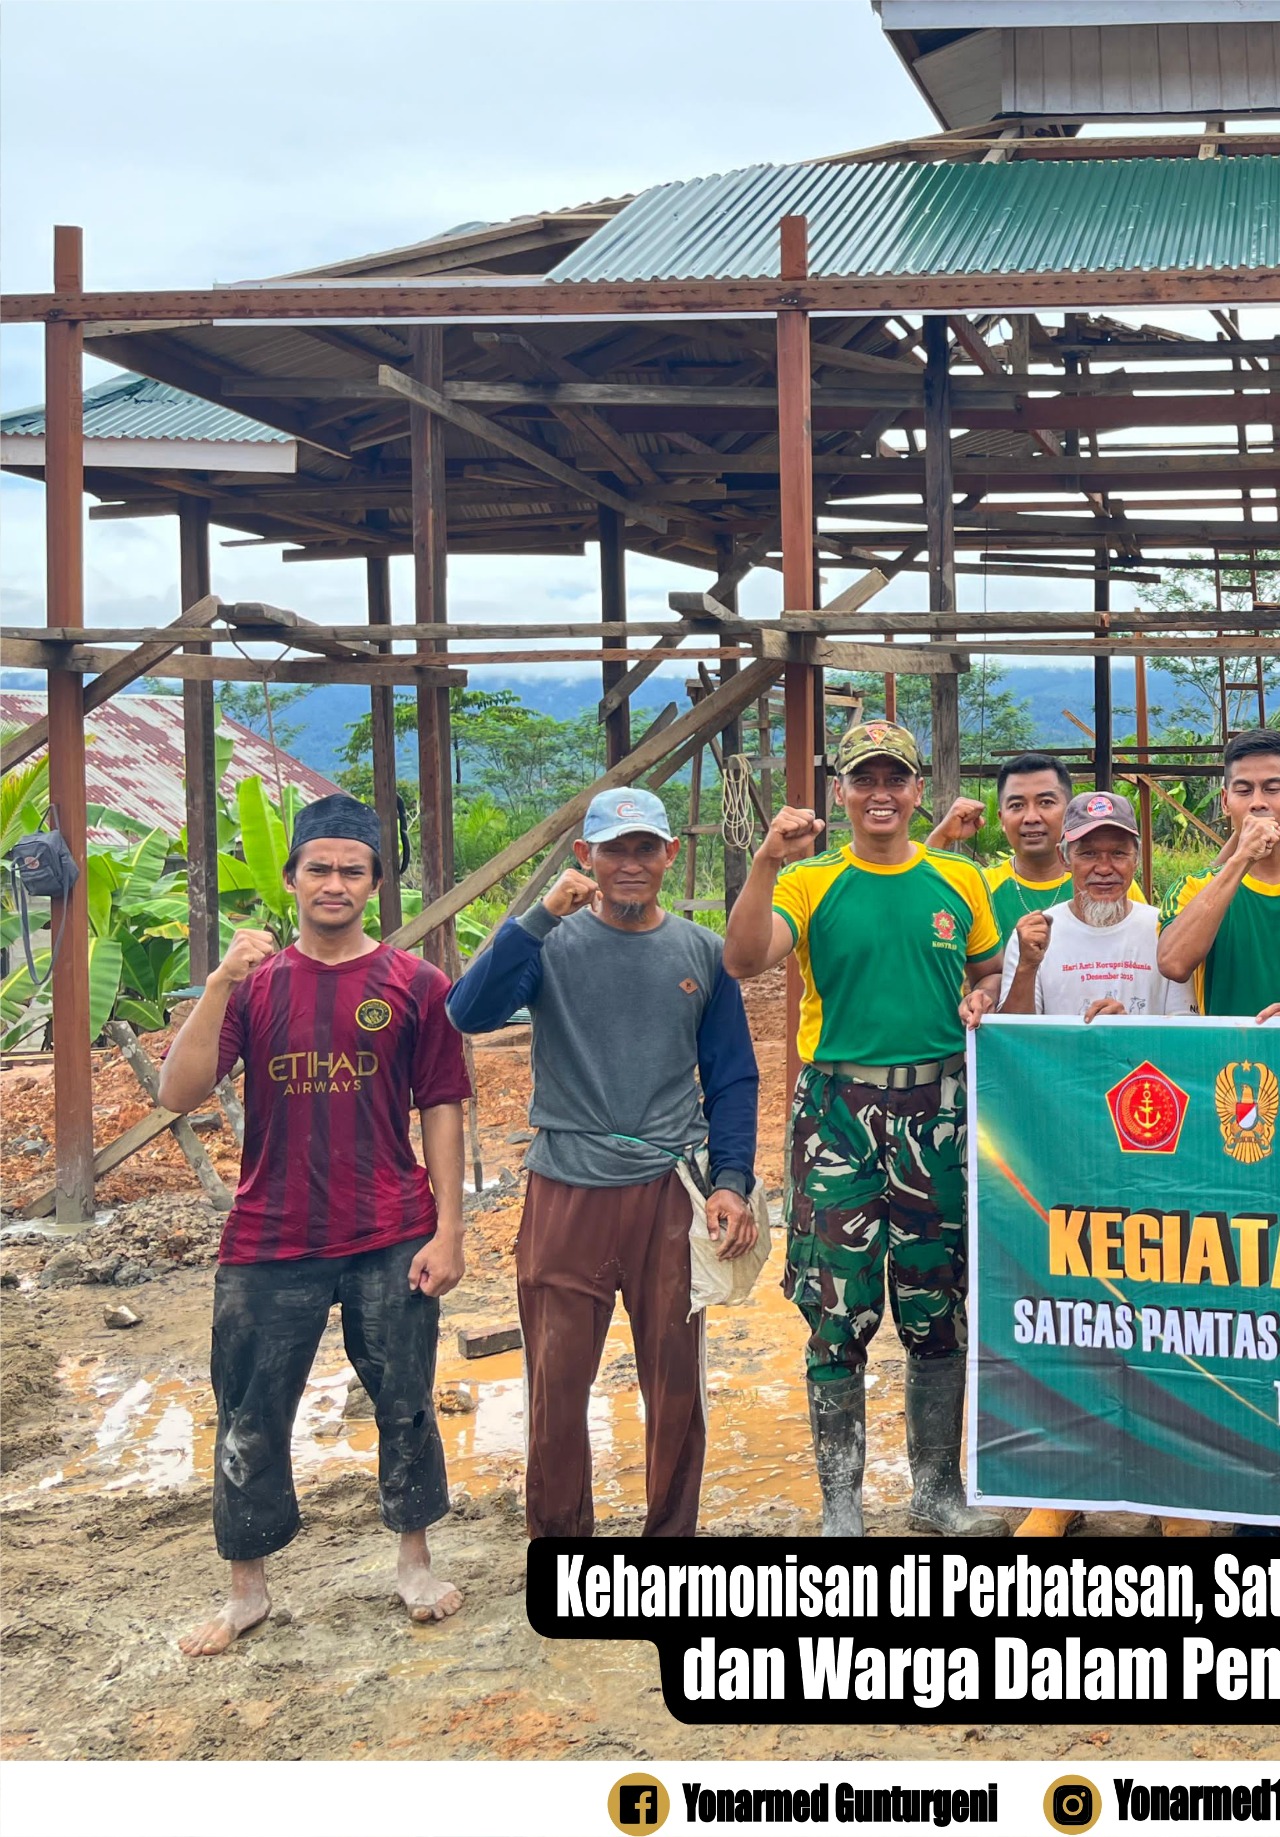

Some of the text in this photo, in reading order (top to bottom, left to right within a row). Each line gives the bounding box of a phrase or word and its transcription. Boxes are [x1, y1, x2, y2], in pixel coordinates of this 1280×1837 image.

[1079, 962, 1094, 970] Anti
[1096, 961, 1123, 970] Korupsi
[1124, 961, 1151, 970] Sedunia
[268, 1051, 379, 1082] ETIHAD
[283, 1079, 362, 1096] AIRWAYS
[1014, 1297, 1136, 1350] SATGAS
[1142, 1306, 1279, 1361] PAMTAS
